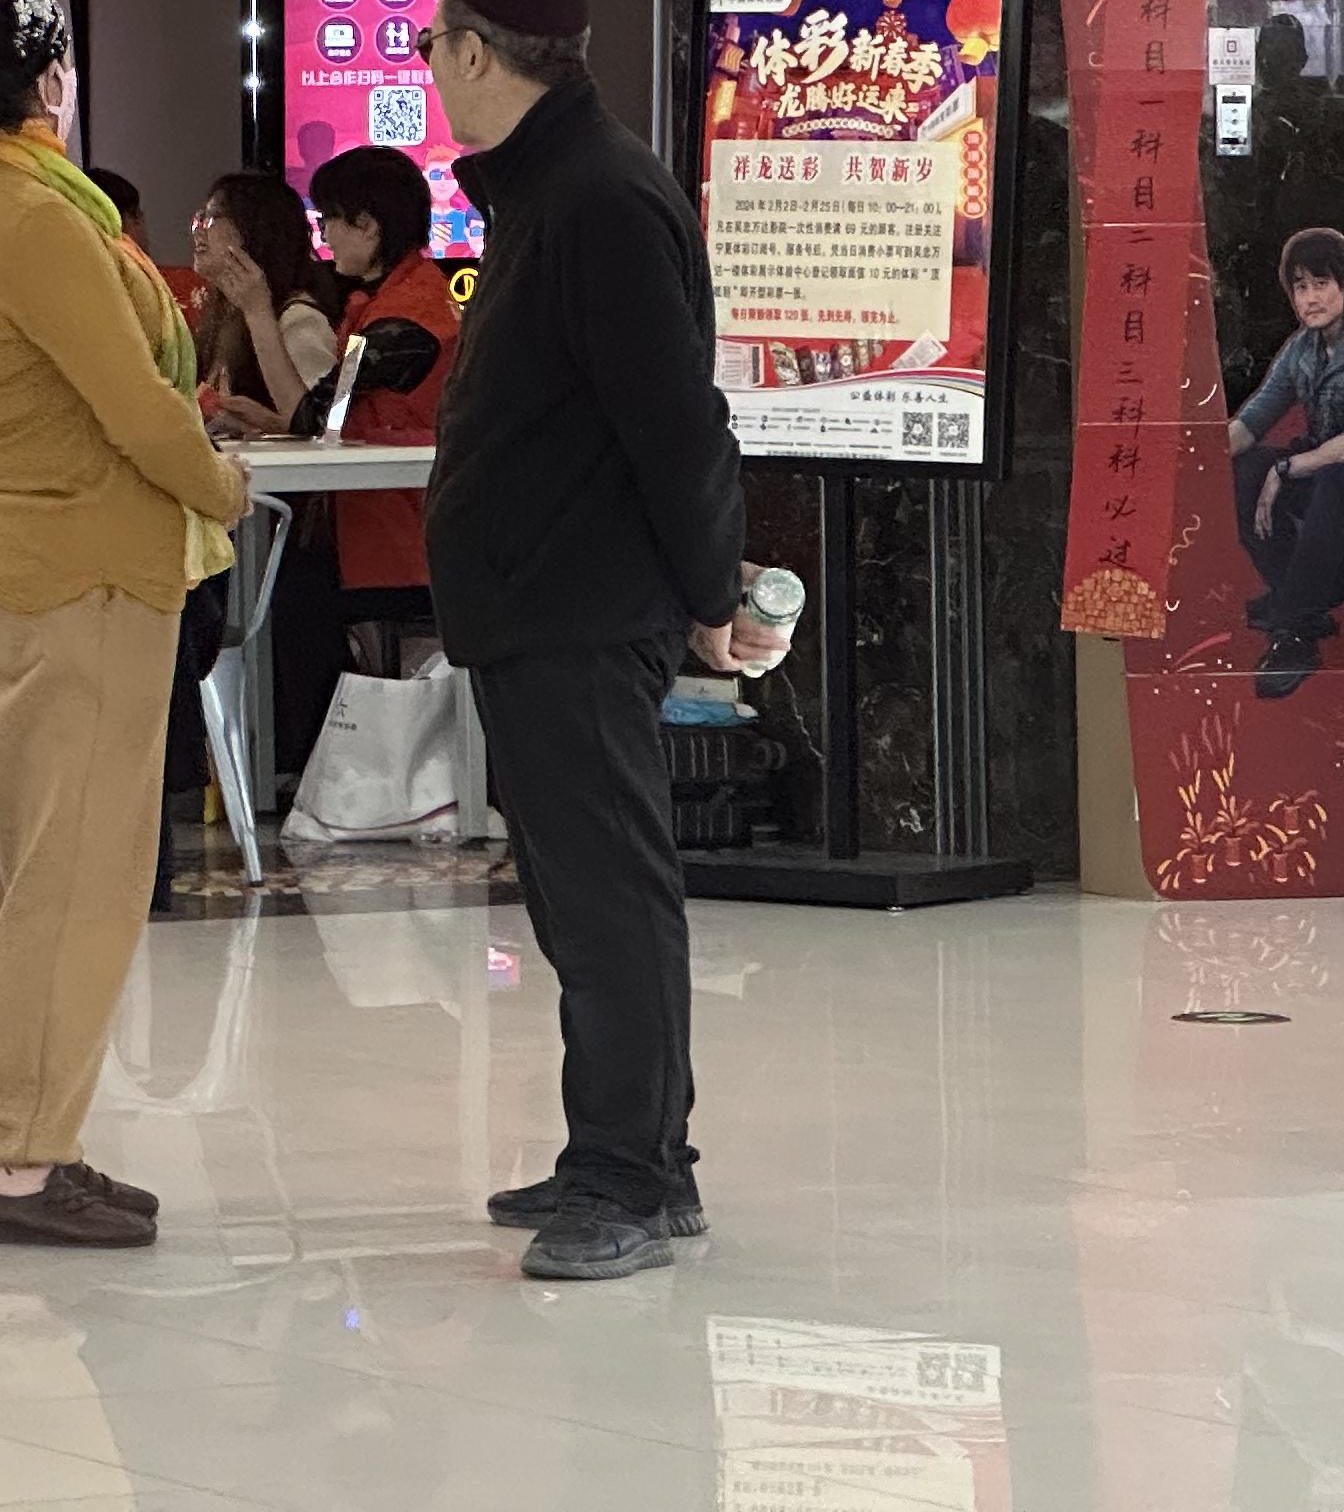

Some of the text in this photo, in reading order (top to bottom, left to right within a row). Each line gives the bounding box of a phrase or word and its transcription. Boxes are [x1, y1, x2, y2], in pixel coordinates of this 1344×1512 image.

[750, 8, 944, 93] 体彩新春季
[776, 81, 910, 124] 龙腾好运来
[733, 155, 934, 183] 祥龙送彩 共贺新岁
[849, 390, 949, 405] 公益体彩 乐善人生
